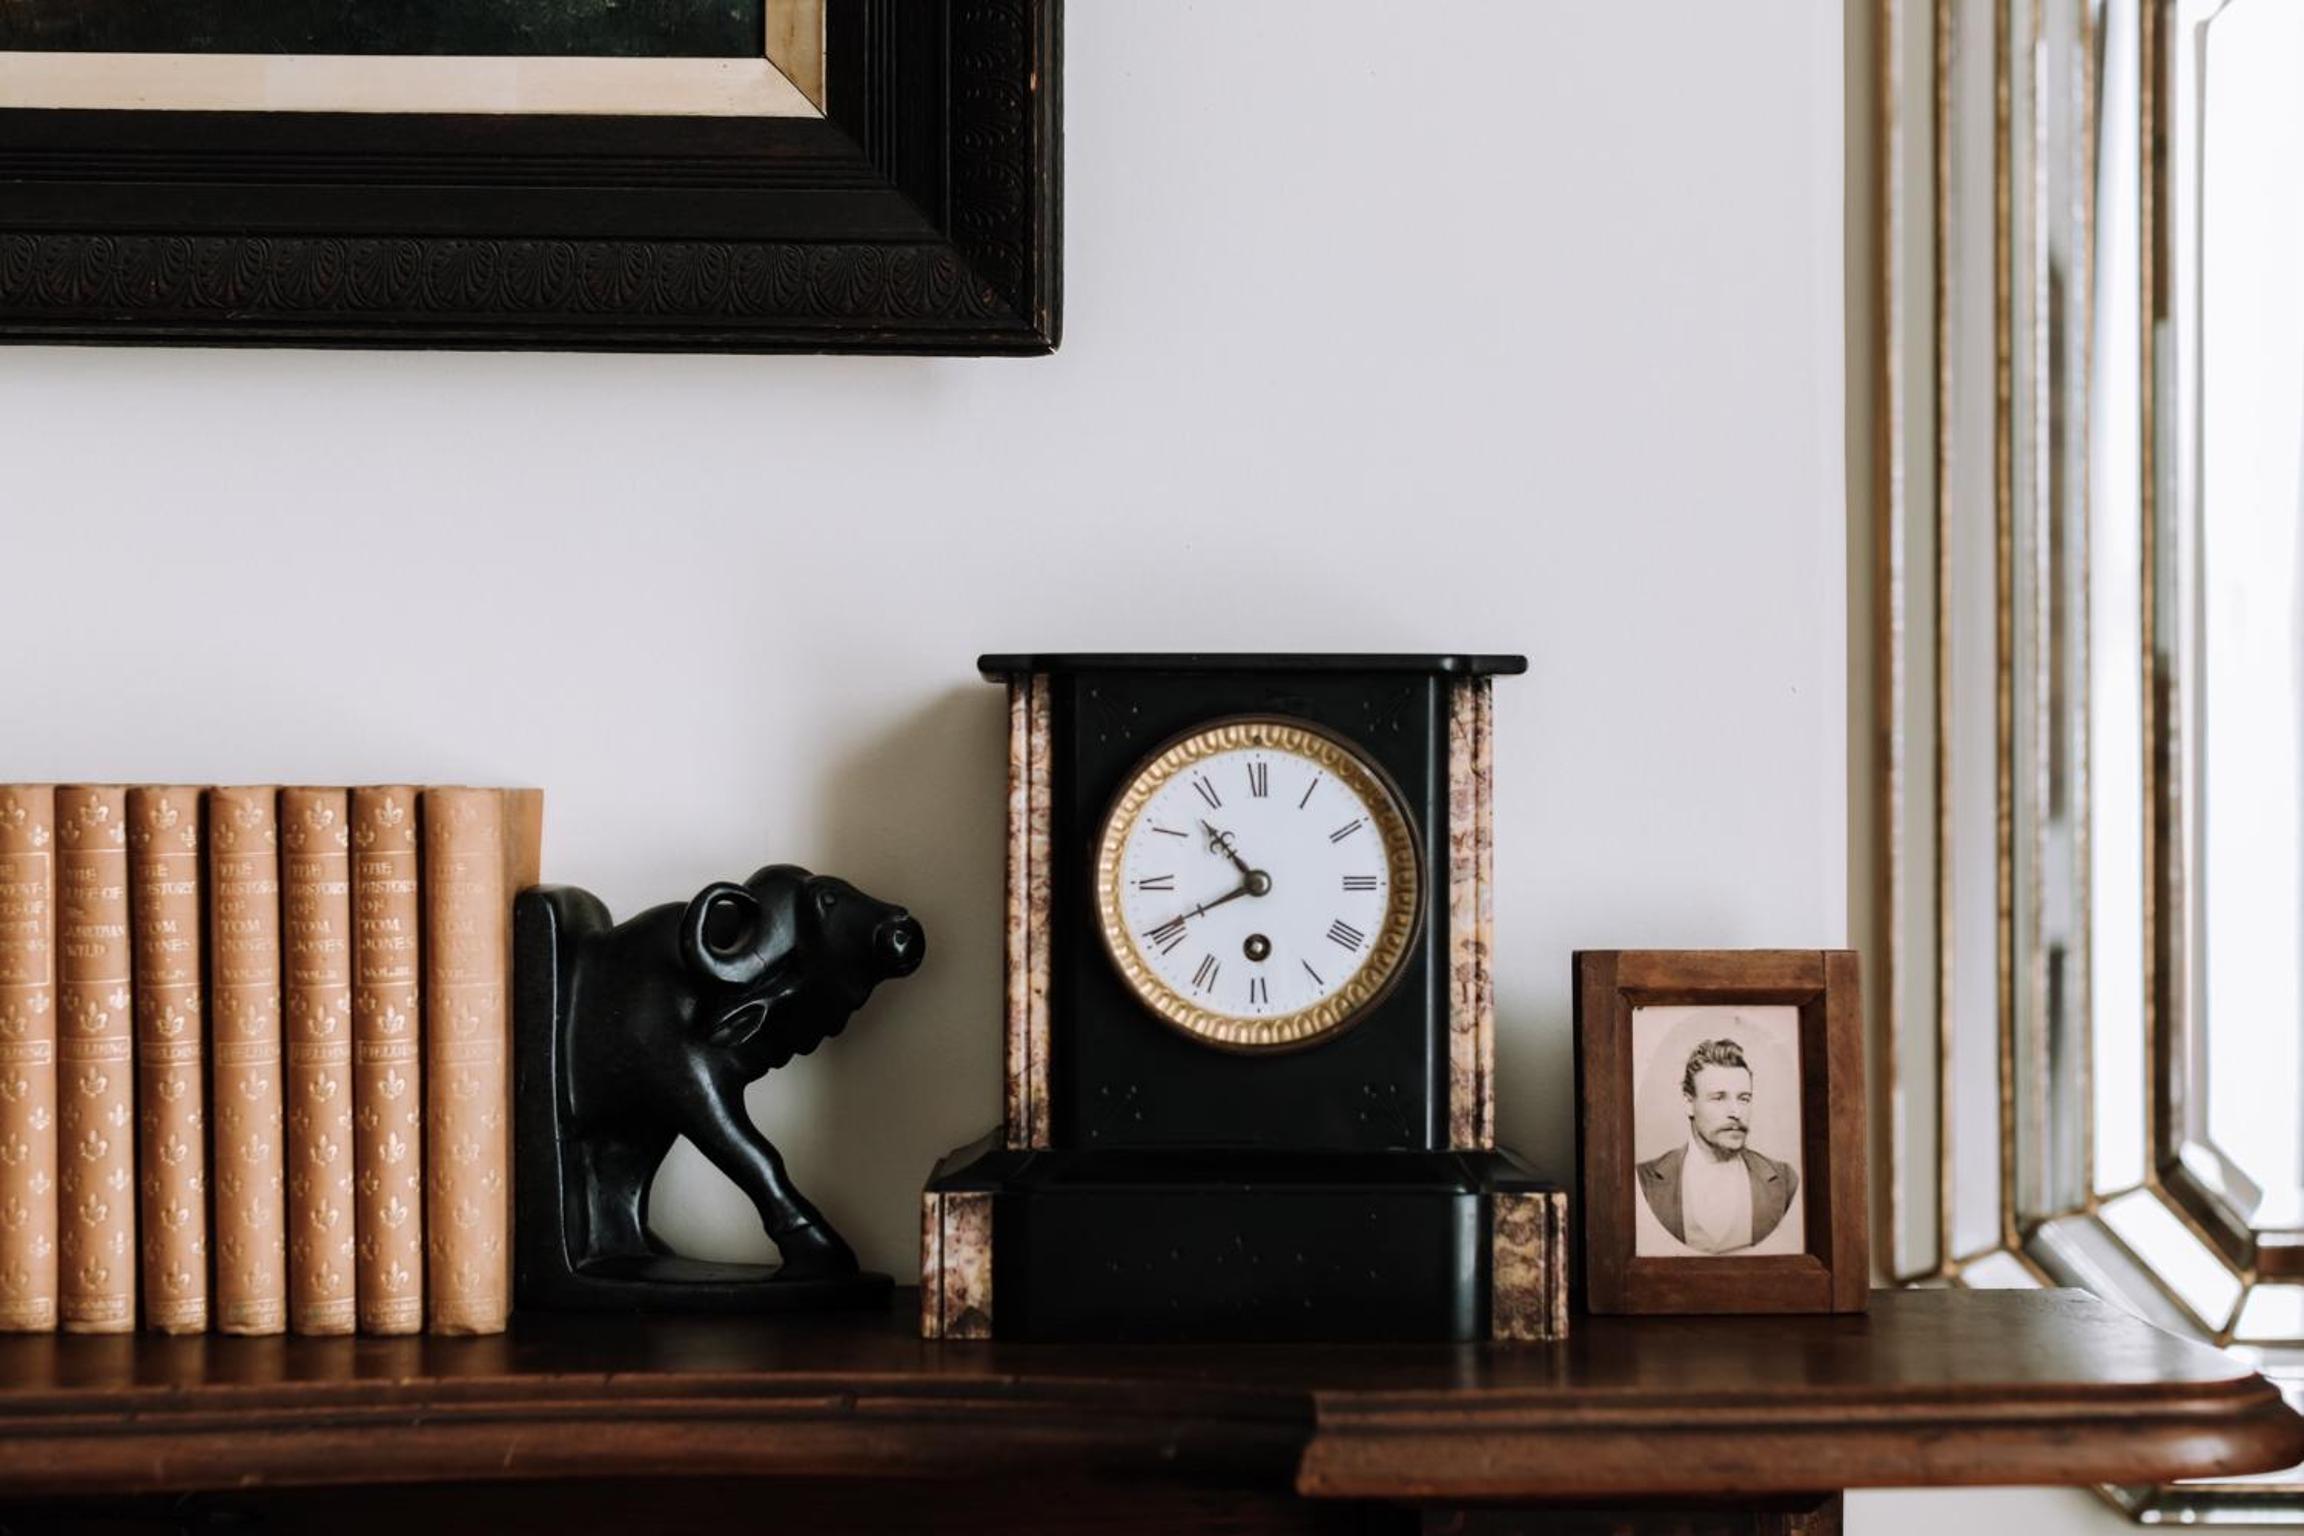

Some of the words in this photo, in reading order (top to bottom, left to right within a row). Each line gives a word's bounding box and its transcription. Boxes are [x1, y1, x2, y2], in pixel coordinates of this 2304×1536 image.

[1297, 777, 1320, 811] I
[1328, 818, 1363, 845] II
[361, 861, 393, 876] THE
[1342, 874, 1377, 892] III
[221, 918, 261, 934] TOM
[291, 919, 331, 934] TOM
[361, 917, 401, 932] TOM
[1325, 918, 1365, 954] IIII
